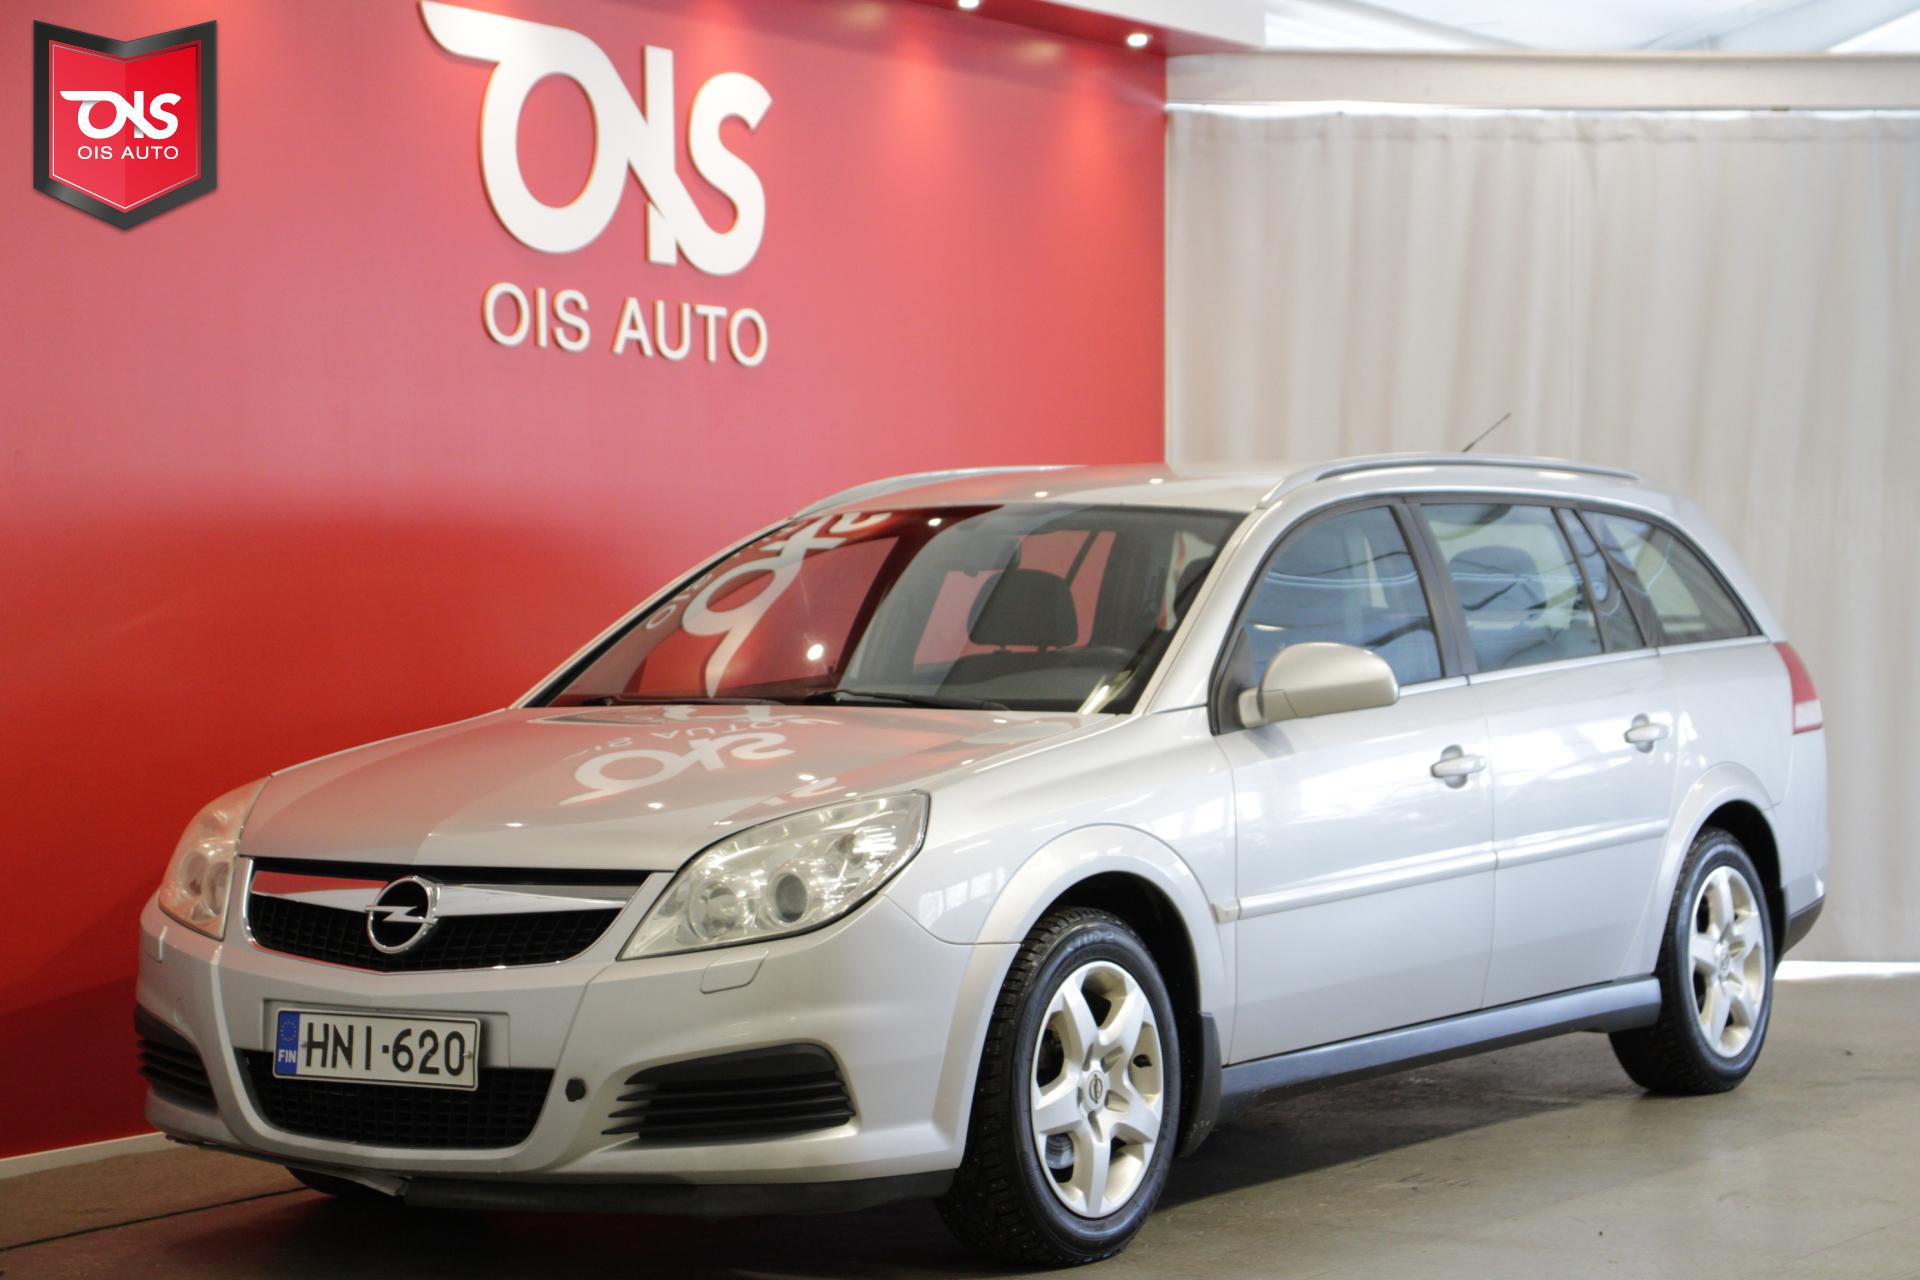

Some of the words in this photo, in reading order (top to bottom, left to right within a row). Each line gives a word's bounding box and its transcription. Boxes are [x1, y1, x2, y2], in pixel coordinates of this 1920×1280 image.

[482, 282, 591, 352] OIS
[611, 297, 768, 367] AUTO
[277, 1049, 297, 1064] FIN
[305, 1022, 466, 1077] HNI-620
